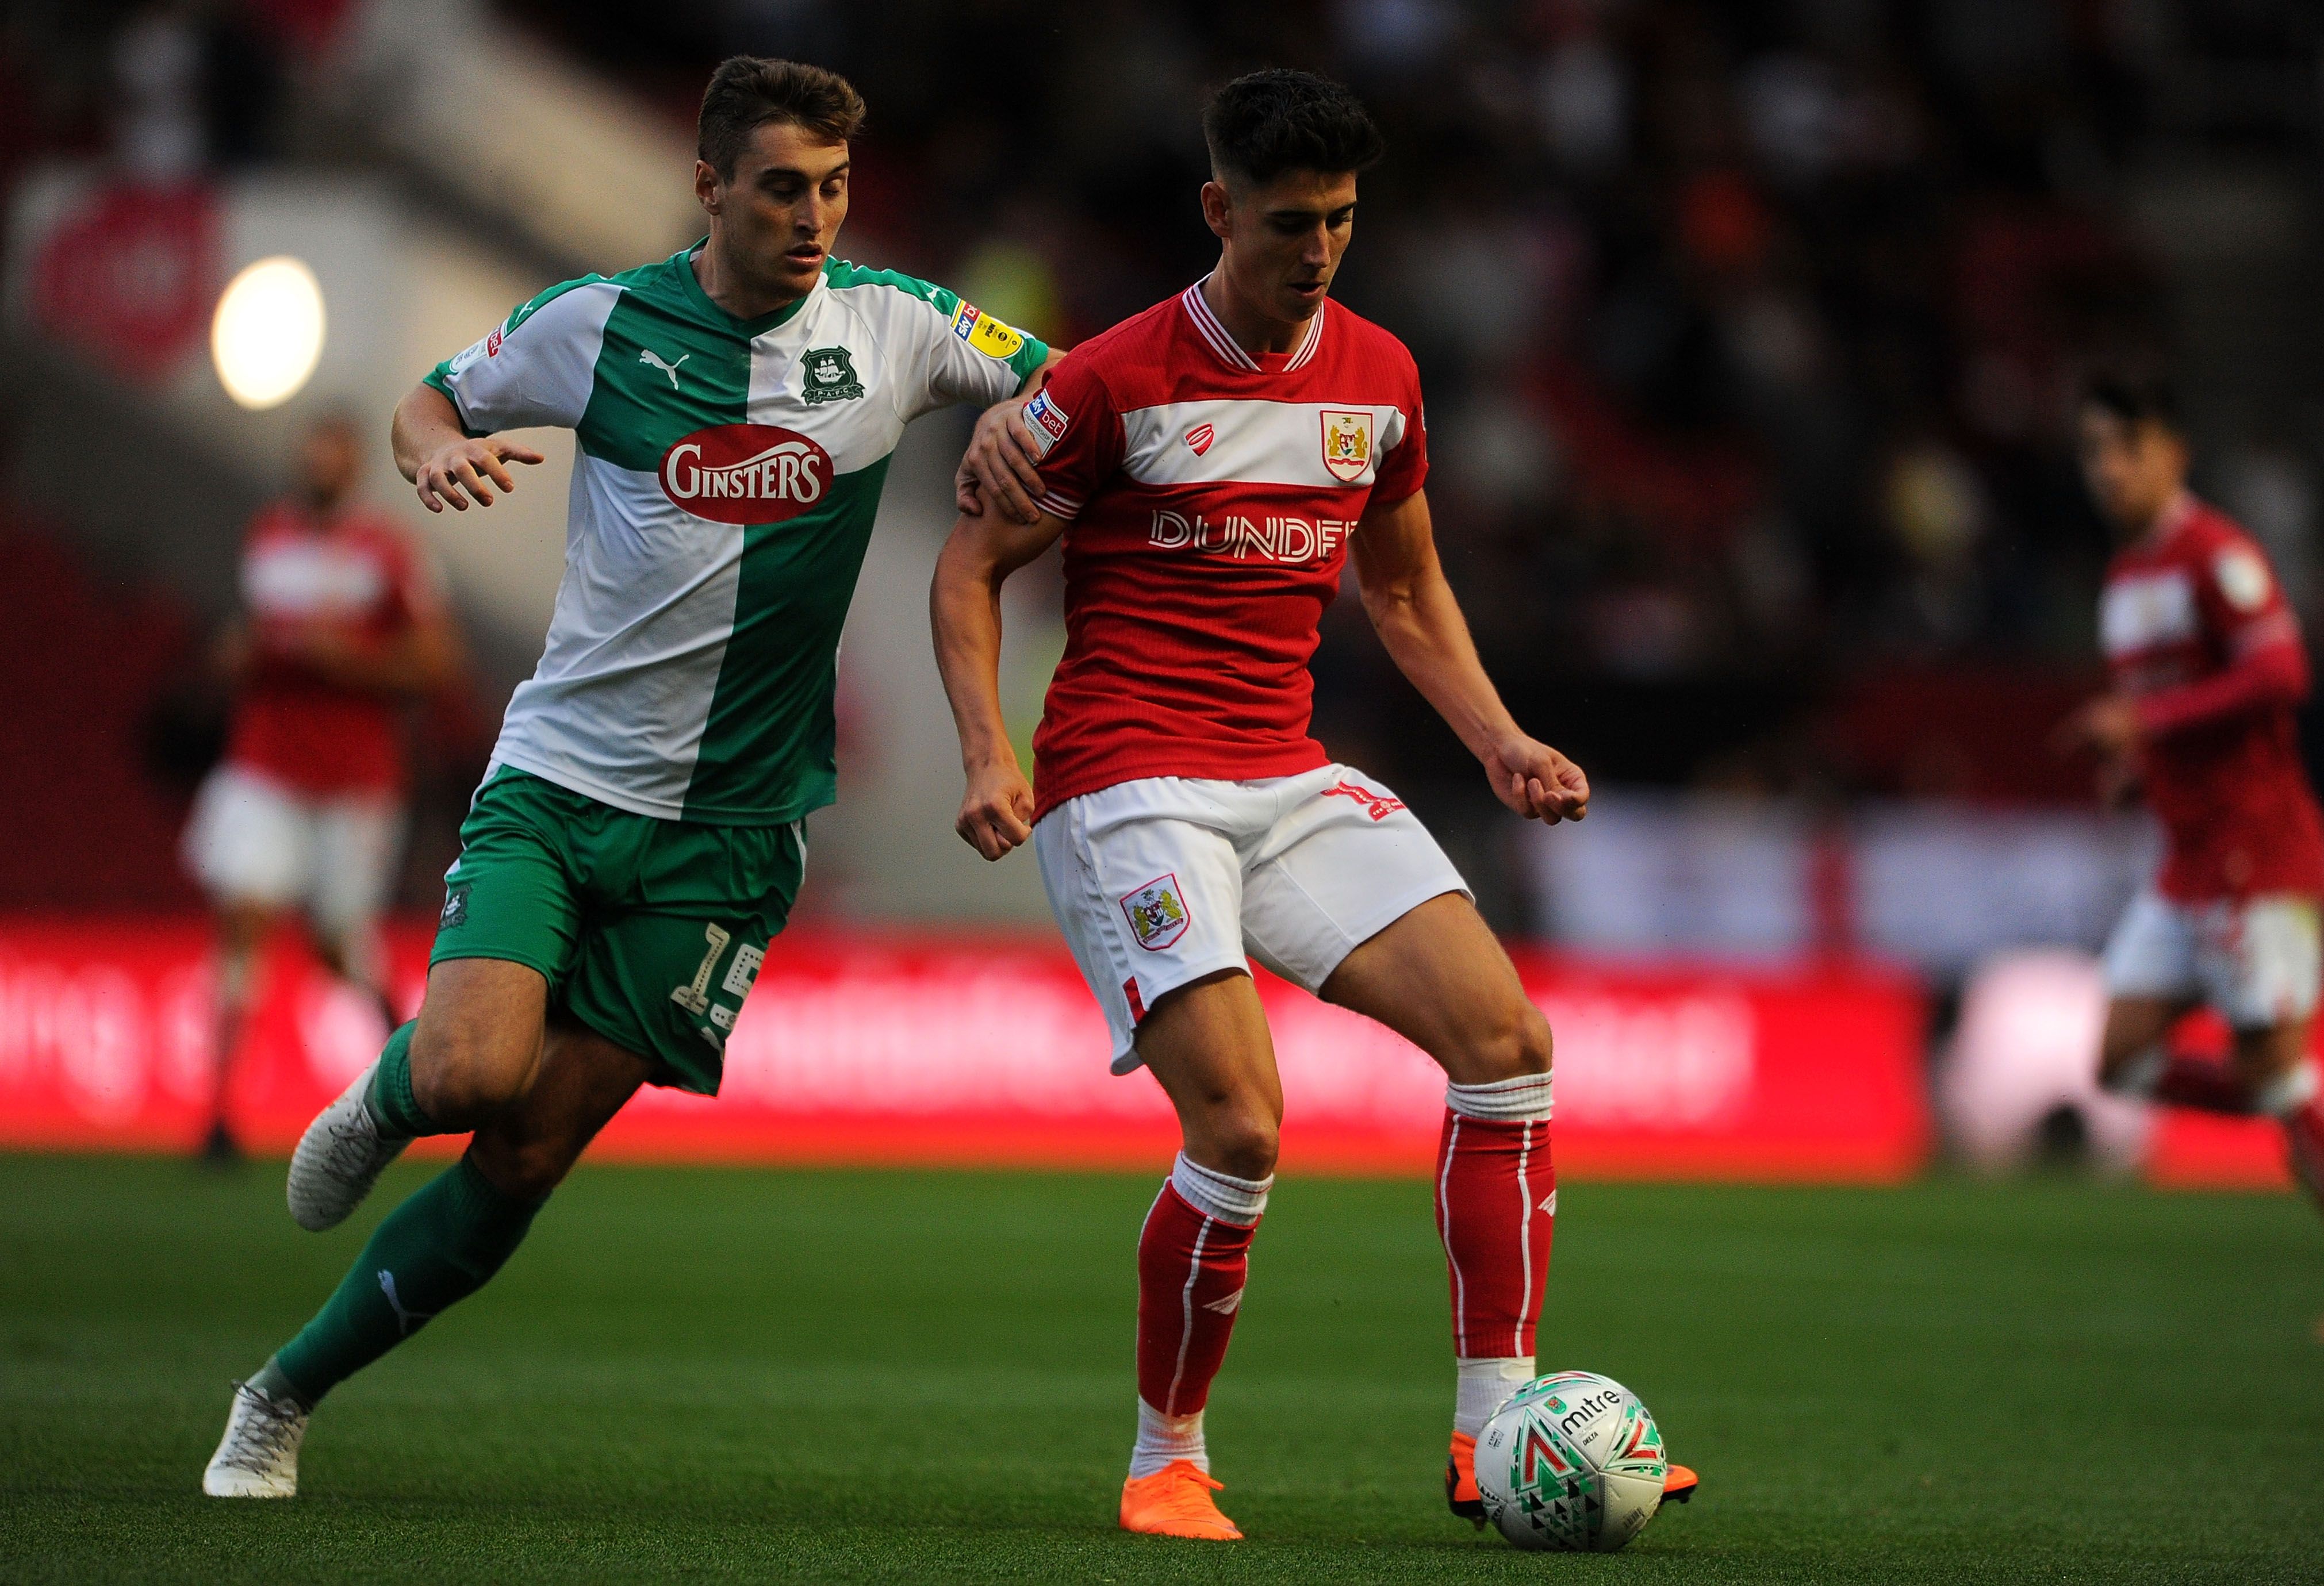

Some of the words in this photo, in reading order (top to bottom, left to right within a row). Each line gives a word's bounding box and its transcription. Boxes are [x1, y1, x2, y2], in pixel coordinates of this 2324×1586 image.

[958, 316, 972, 337] sky
[984, 322, 996, 338] FUN
[1032, 398, 1044, 414] sky
[1041, 410, 1061, 434] bet
[1561, 1391, 1620, 1435] mitre
[1582, 1432, 1598, 1446] DELTA
